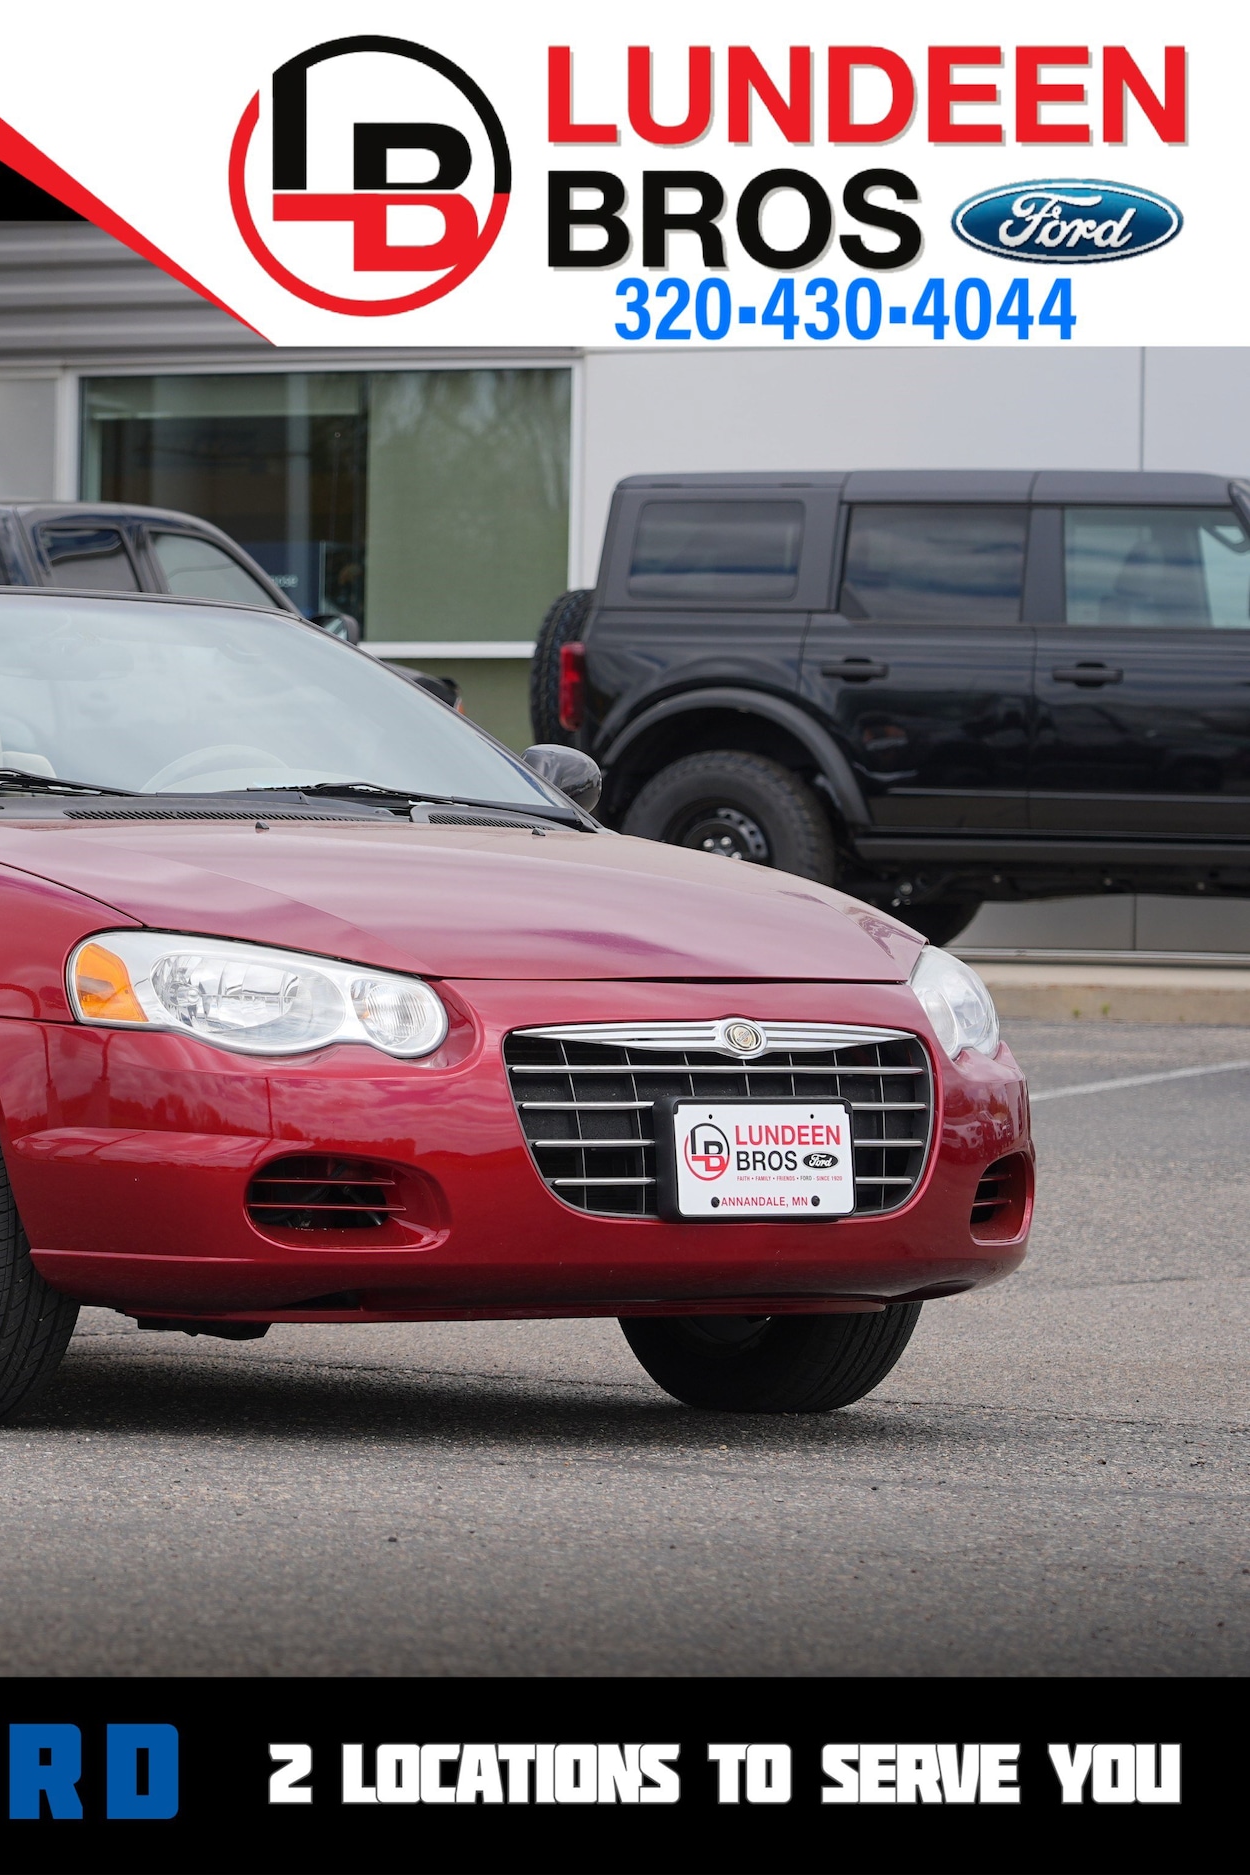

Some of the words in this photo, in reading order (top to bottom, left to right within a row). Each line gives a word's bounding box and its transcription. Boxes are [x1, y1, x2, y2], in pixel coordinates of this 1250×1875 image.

[735, 1125, 841, 1147] LUNDEEN
[736, 1150, 798, 1172] BROS
[808, 1153, 833, 1168] Ford
[720, 1196, 789, 1208] ANNANDALE,
[791, 1196, 808, 1207] MN
